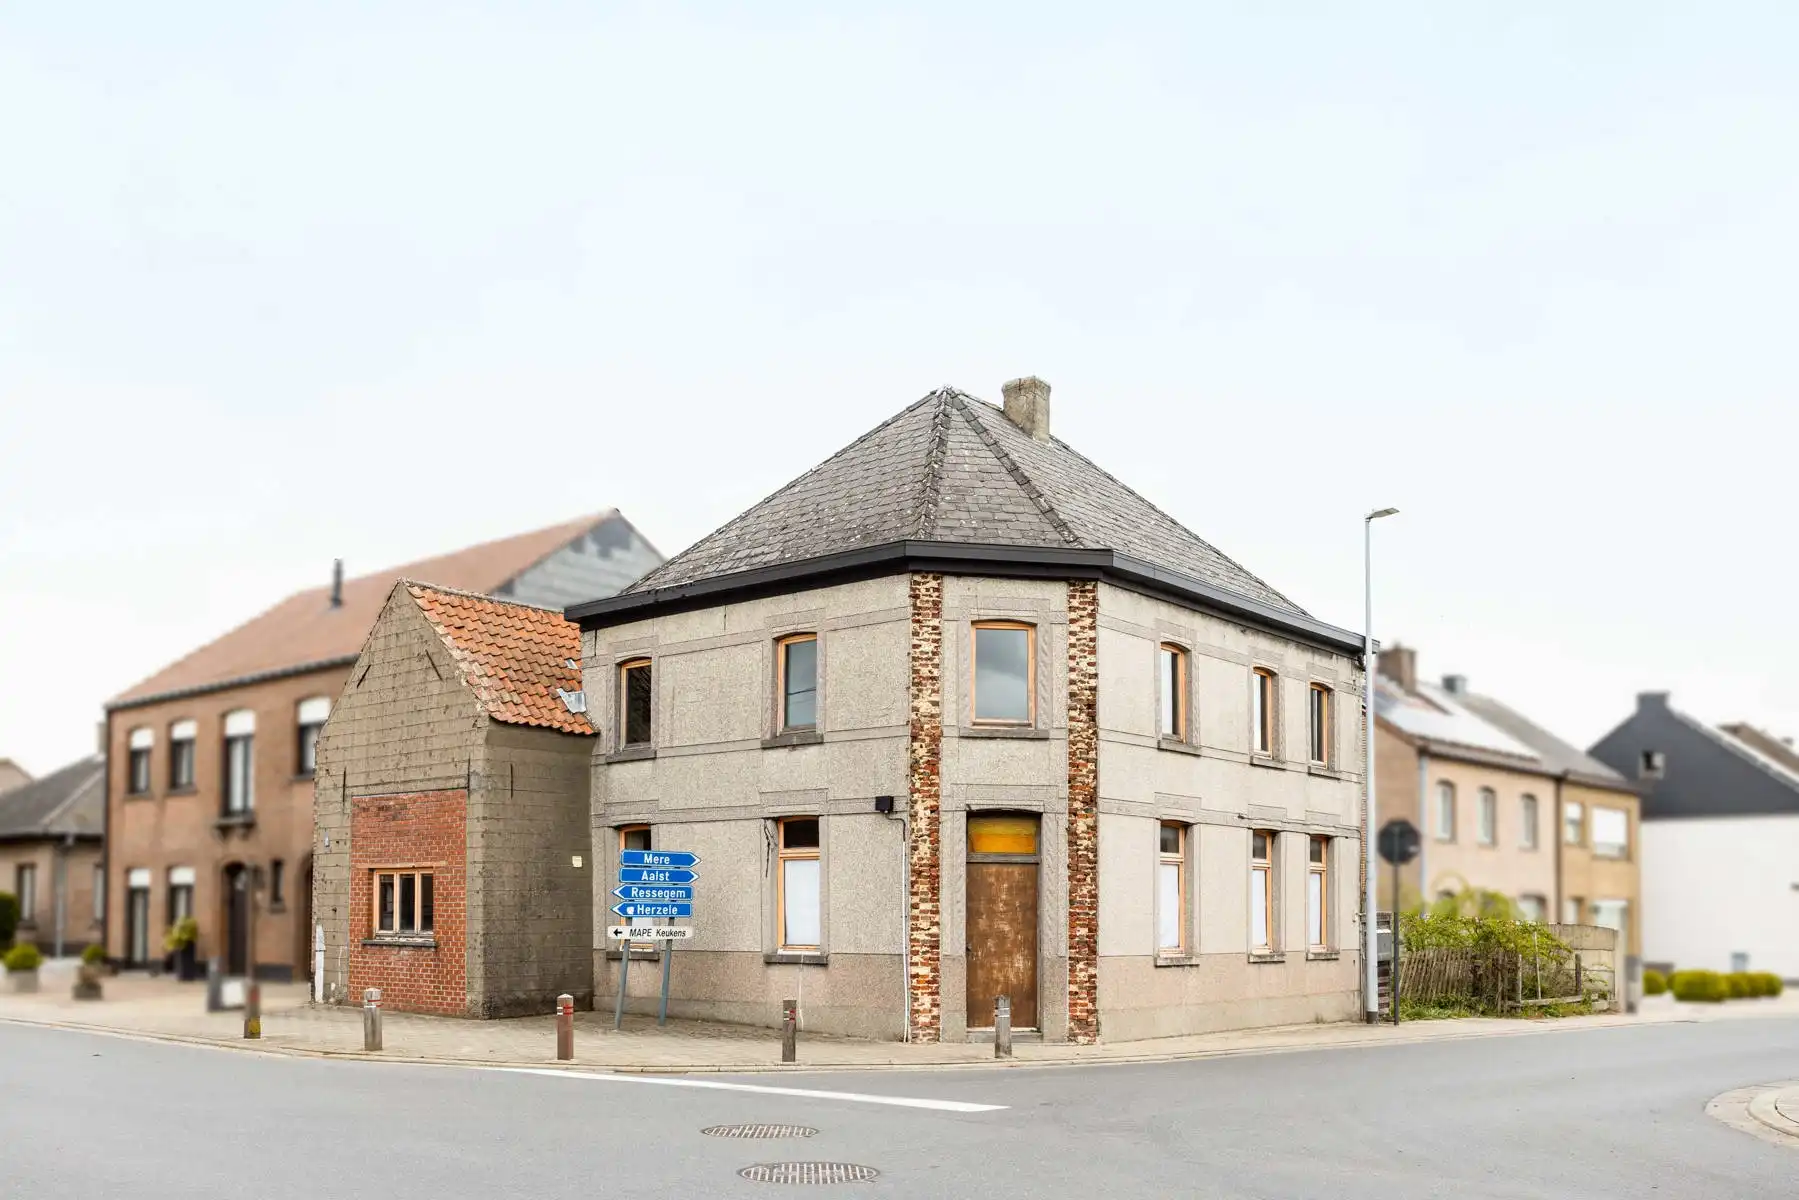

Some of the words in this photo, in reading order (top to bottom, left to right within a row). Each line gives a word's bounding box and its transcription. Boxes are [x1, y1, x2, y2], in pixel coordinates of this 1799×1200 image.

[643, 853, 670, 864] Mere
[641, 870, 670, 881] Aalst
[631, 887, 686, 900] Ressegem
[637, 904, 678, 915] Herzele
[629, 928, 652, 937] MAPE
[656, 928, 687, 937] Keukens
